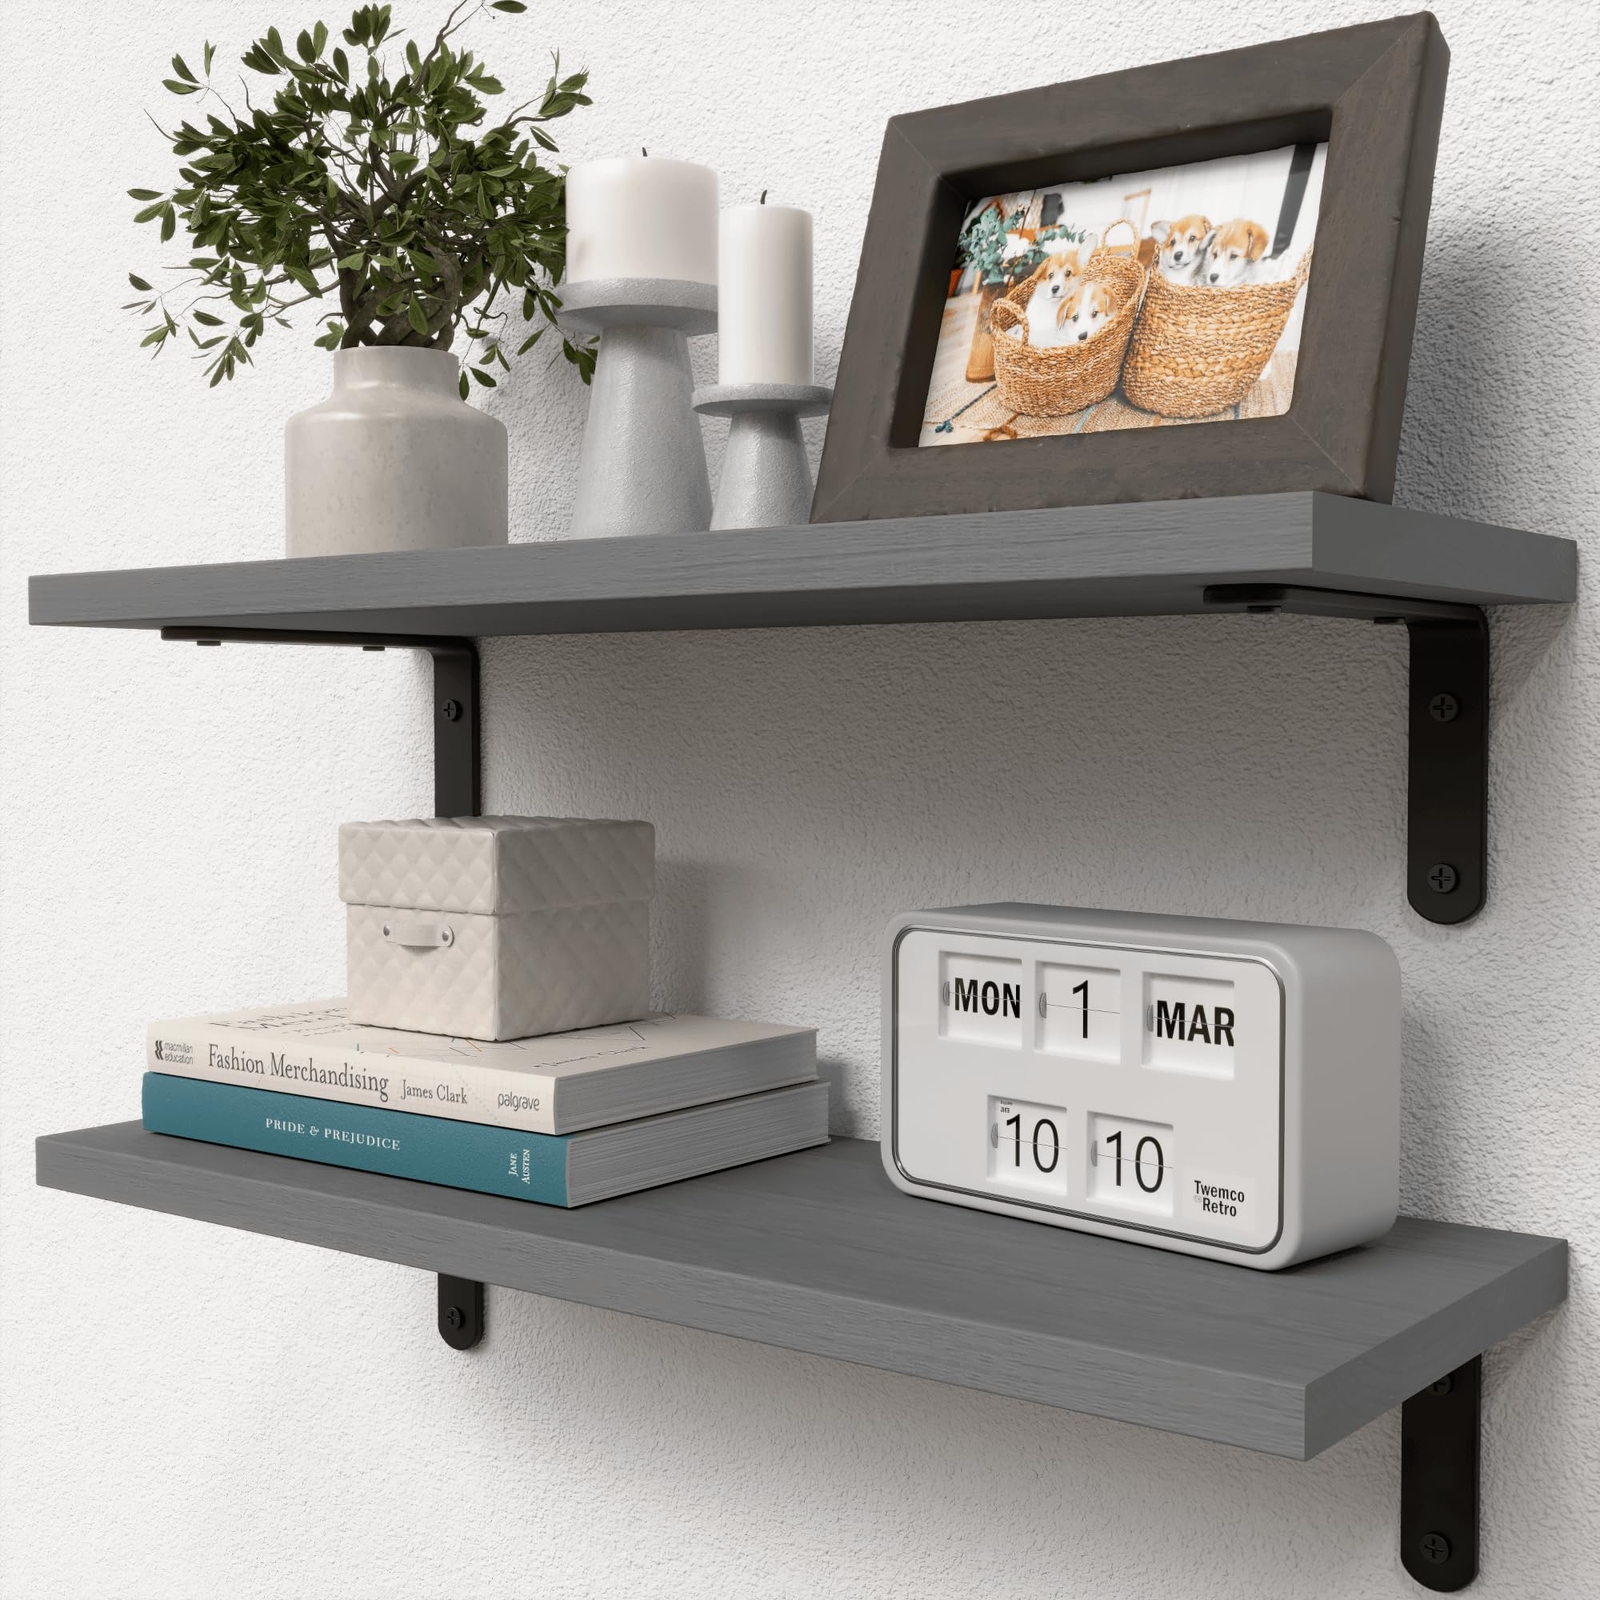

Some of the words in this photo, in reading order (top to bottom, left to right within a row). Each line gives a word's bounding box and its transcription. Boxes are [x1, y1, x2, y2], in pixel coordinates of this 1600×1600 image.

[954, 977, 1021, 1019] MON
[1072, 979, 1089, 1039] 1
[1156, 999, 1235, 1047] MAR
[164, 1041, 194, 1054] macmillan
[164, 1052, 194, 1065] education
[208, 1043, 265, 1075] Fashion
[270, 1052, 389, 1103] Merchandising
[401, 1079, 433, 1100] James
[436, 1084, 468, 1104] Clark
[497, 1091, 540, 1112] palgrave
[265, 1118, 305, 1134] PRIDE
[309, 1125, 320, 1136] &
[324, 1128, 400, 1151] PREJUDICE
[1005, 1113, 1060, 1174] 10
[1105, 1130, 1164, 1194] 10
[1193, 1180, 1245, 1203] Twemco
[1202, 1197, 1237, 1217] Retro
